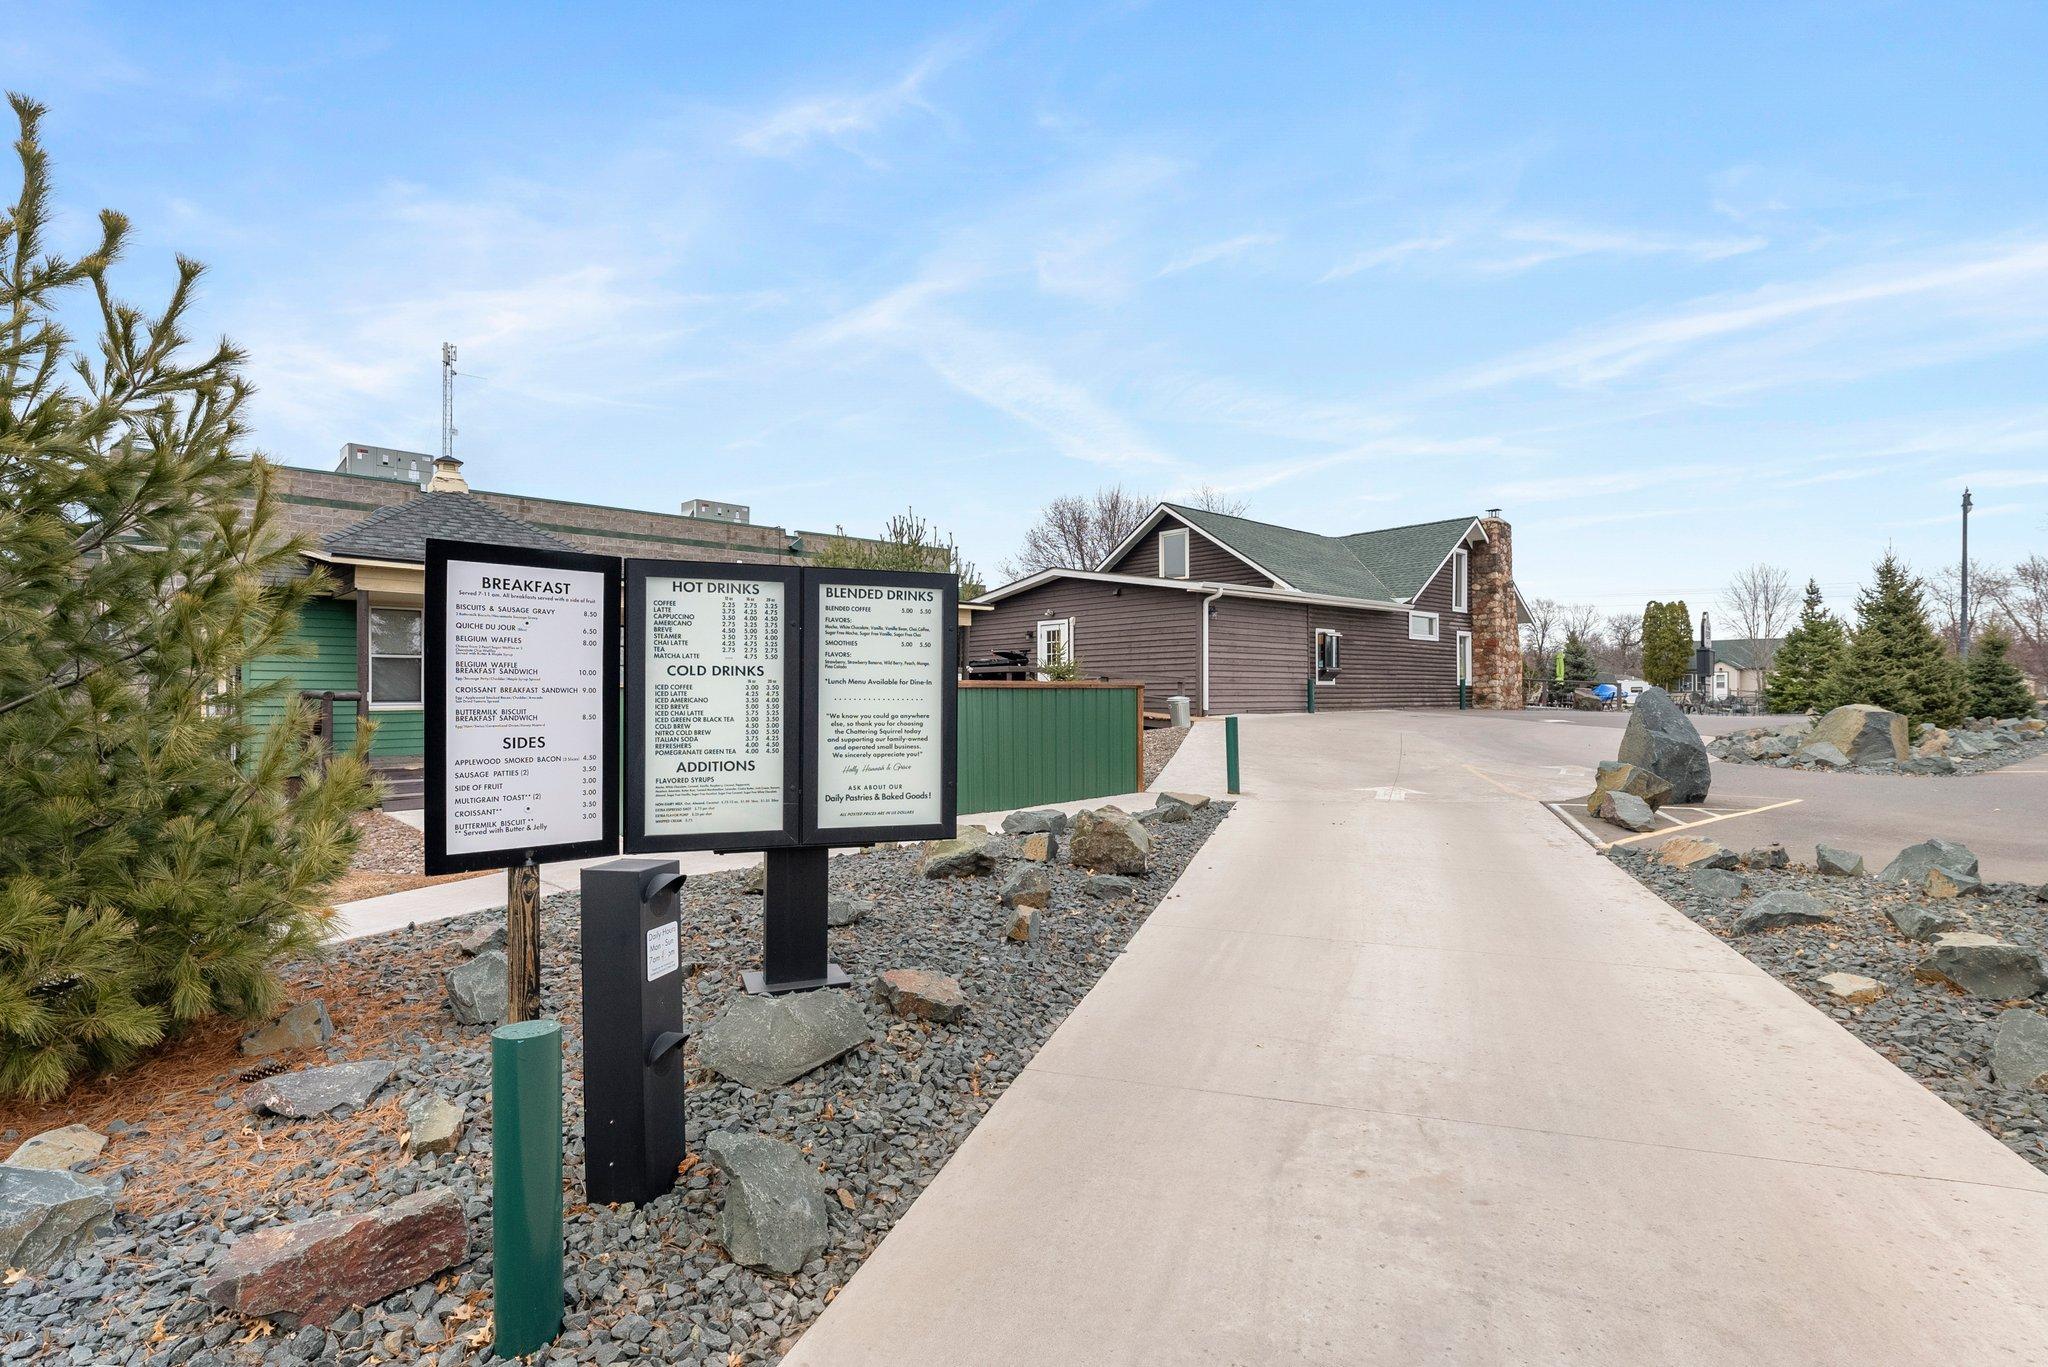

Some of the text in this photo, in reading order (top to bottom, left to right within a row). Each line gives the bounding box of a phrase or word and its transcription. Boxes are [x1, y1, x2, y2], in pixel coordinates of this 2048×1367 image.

[482, 576, 571, 595] BREAKFAST
[672, 581, 760, 595] HOT DRINKS
[826, 587, 934, 602] BLENDED DRINKS
[455, 603, 486, 612] BISCUITS
[498, 605, 530, 614] SAUSAGE
[532, 607, 556, 615] GRAVY
[455, 622, 484, 630] QUICHE
[455, 635, 488, 643] BELGIUM
[666, 665, 764, 676] COLD DRINKS
[455, 686, 497, 694] CROISSANT
[845, 728, 878, 736] Chattering
[502, 736, 546, 749] SIDES
[454, 758, 501, 766] APPLEWOOD
[504, 756, 534, 764] SMOKED
[676, 760, 756, 773] ADDITIONS
[454, 771, 489, 779] SAUSAGE
[520, 769, 530, 777] (2)
[454, 796, 500, 805] MULTIGRAIN
[533, 793, 542, 801] (2)
[825, 794, 844, 803] Daily
[845, 794, 873, 802] Pastries
[881, 792, 904, 800] Baked
[905, 792, 932, 800] Goods!
[454, 818, 526, 831] BUTTERMILK BISCUIT
[463, 828, 487, 836] Served
[505, 825, 525, 833] Butter
[533, 823, 548, 831] Jelly
